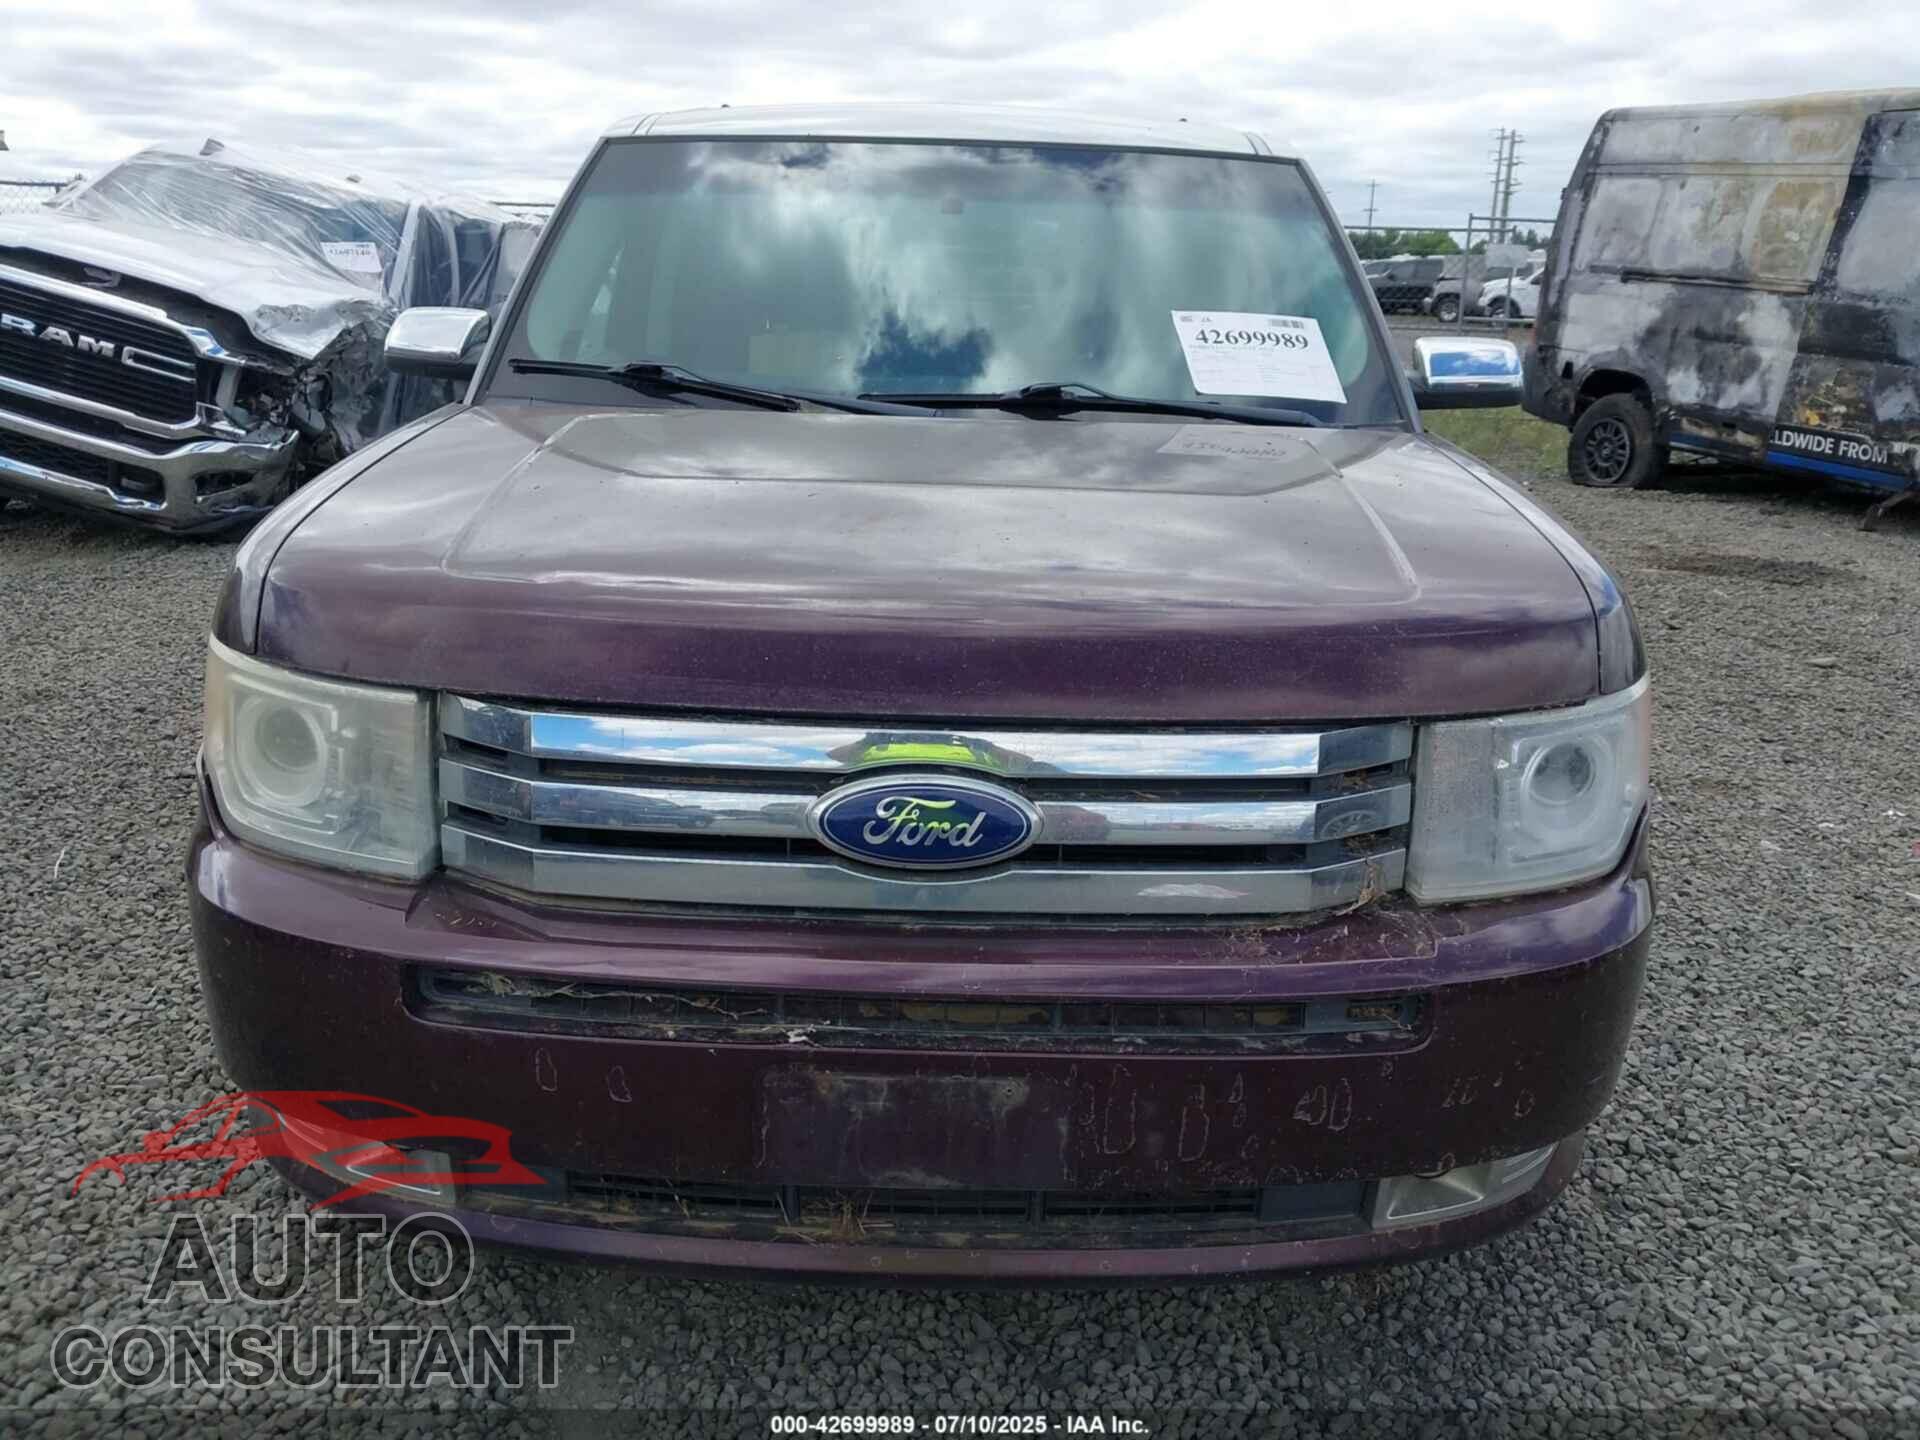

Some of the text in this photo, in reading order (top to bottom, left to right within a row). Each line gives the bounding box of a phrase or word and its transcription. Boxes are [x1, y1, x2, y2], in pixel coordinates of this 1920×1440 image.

[1, 313, 115, 358] RAM
[1195, 328, 1309, 351] 42699989
[1769, 429, 1888, 464] LDWIDE FROM
[863, 795, 984, 847] Ford
